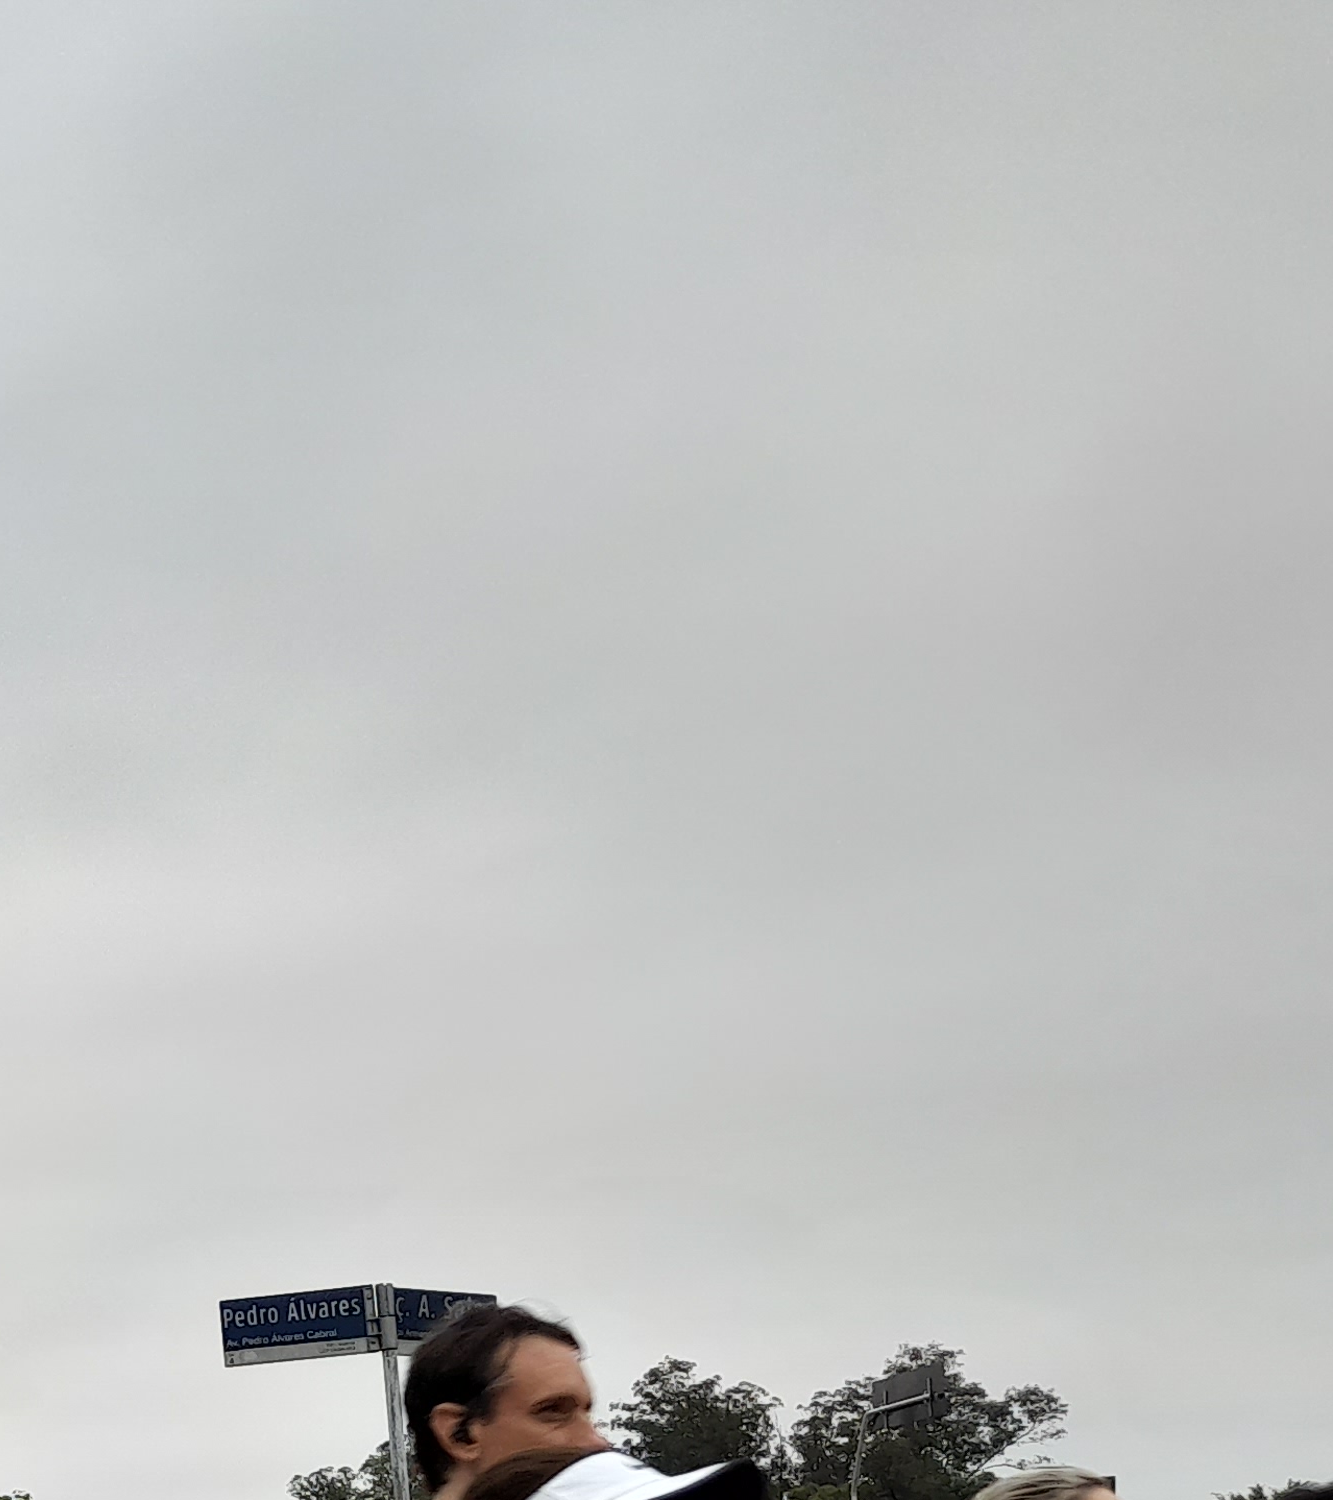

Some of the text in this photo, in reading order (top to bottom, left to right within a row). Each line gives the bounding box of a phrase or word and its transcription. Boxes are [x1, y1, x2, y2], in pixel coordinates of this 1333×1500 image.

[222, 1296, 362, 1329] Pedro Álvares
[242, 1335, 269, 1347] Pedro
[271, 1331, 305, 1343] Álvares
[306, 1328, 338, 1340] Cabral
